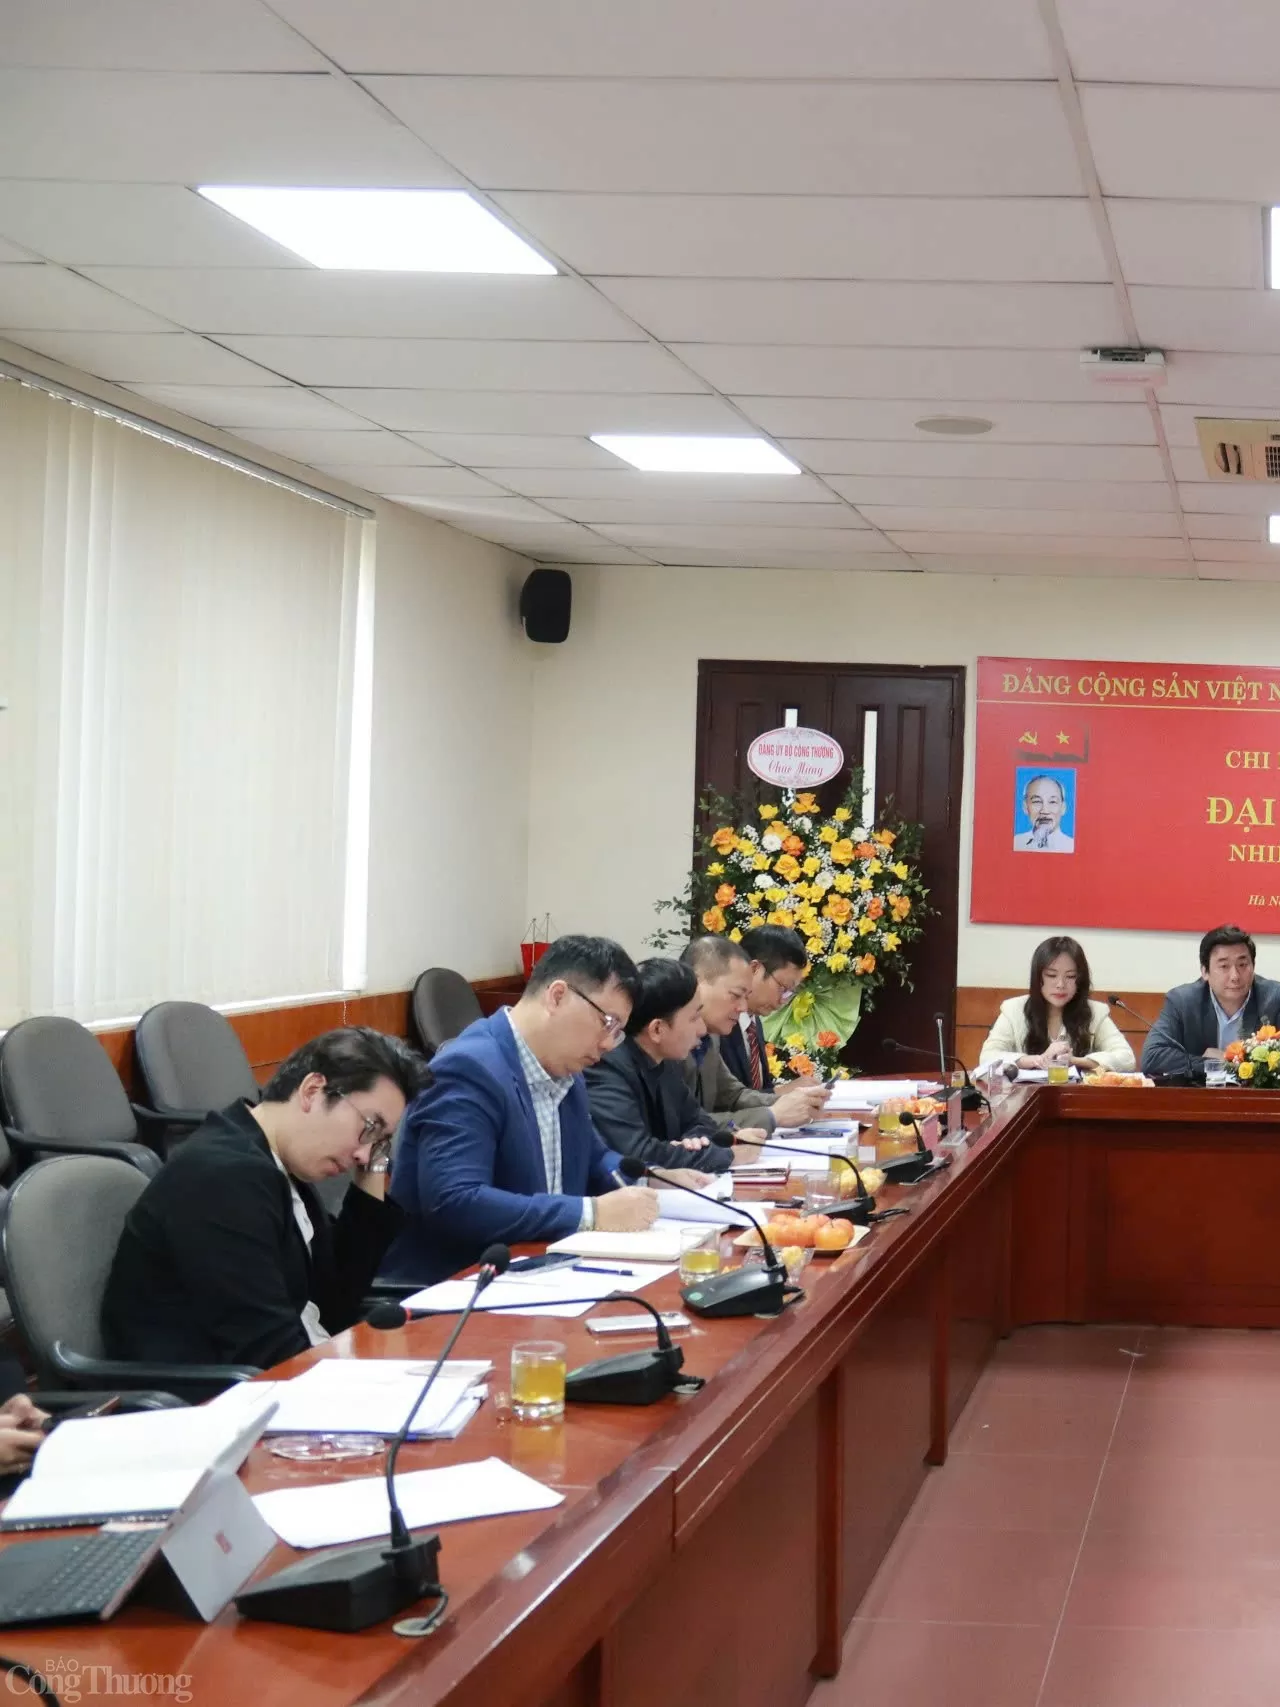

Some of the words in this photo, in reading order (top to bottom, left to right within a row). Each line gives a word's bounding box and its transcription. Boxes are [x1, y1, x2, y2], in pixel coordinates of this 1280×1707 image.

[1002, 667, 1072, 695] ĐẢNG
[1078, 671, 1147, 701] CỘNG
[1152, 671, 1200, 699] SẢN
[1205, 675, 1263, 705] VIỆT
[785, 742, 793, 759] BỘ
[1225, 750, 1270, 770] CHI
[1206, 796, 1276, 833] ĐẠI
[1248, 894, 1265, 906] Hà
